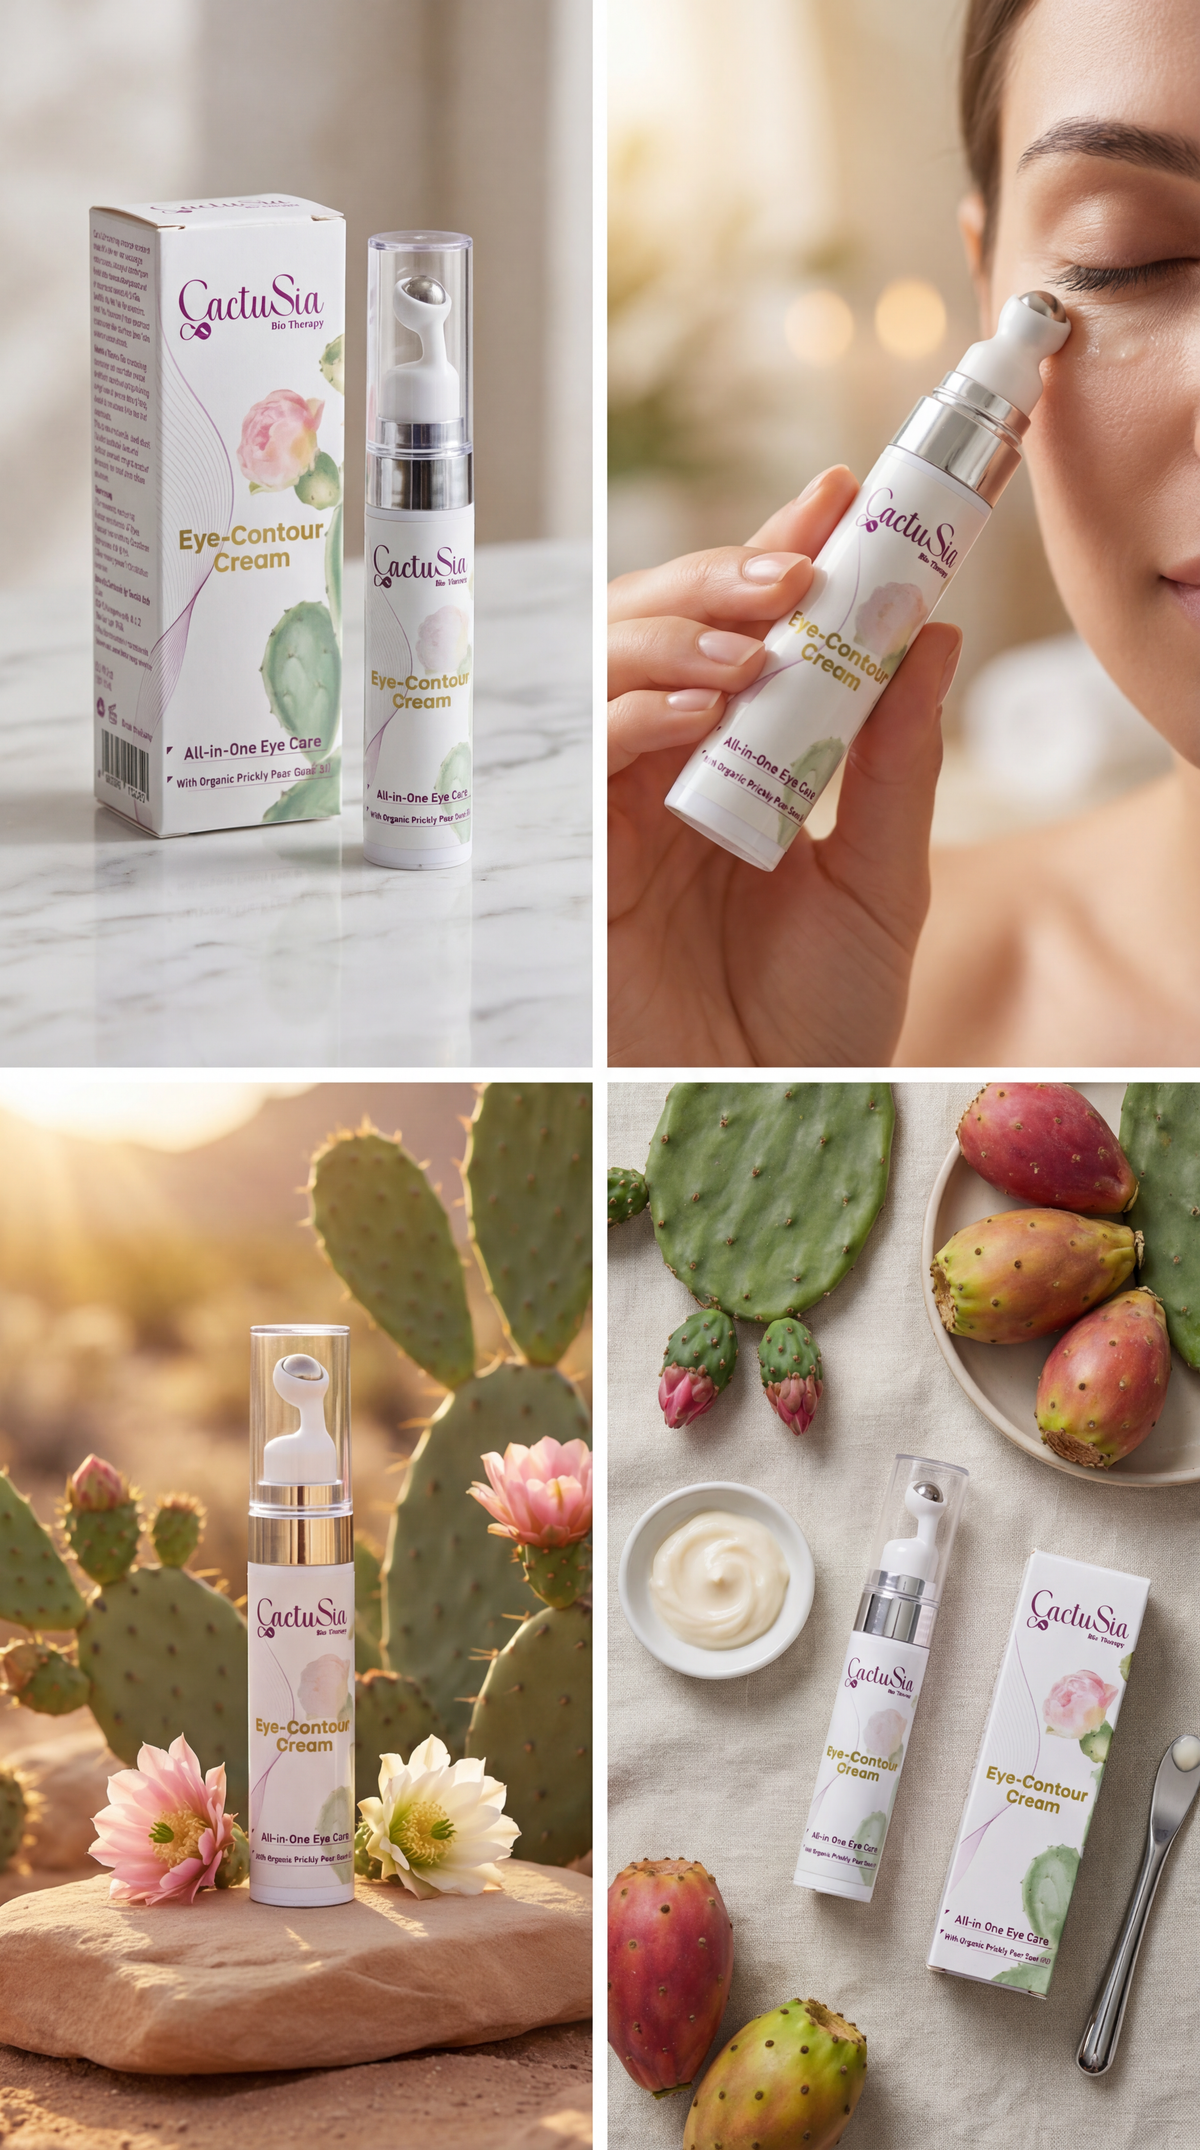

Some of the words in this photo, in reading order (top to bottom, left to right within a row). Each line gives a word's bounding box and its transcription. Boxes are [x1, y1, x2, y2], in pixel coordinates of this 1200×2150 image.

[178, 274, 324, 322] CactuSia
[271, 321, 285, 331] Bio
[288, 320, 324, 331] Therapy
[179, 523, 324, 553] Eye-Contour
[866, 486, 959, 569] CactuSia
[214, 551, 290, 573] Cream
[374, 544, 468, 579] CactuSia
[788, 610, 889, 685] Eye-Contour
[801, 643, 862, 692] Cream
[371, 670, 470, 691] Eye-Contour
[392, 693, 452, 709] Cream
[184, 744, 257, 761] All-in-One
[261, 739, 285, 756] Eye
[290, 736, 322, 750] Care
[723, 736, 779, 775] All-in-One
[779, 768, 799, 788] Eye
[176, 777, 198, 788] With
[199, 773, 235, 788] Organic
[237, 769, 268, 783] Prickly
[377, 789, 429, 803] All-in-One
[431, 792, 450, 805] Eye
[383, 813, 410, 825] Organic
[257, 1598, 347, 1628] CactuSia
[1031, 1590, 1129, 1640] CactuSia
[848, 1657, 914, 1693] CactuSia
[255, 1718, 350, 1737] Eye-Contour
[276, 1737, 333, 1753] Cream
[827, 1746, 898, 1772] Eye-Contour
[837, 1762, 880, 1782] Cream
[986, 1766, 1089, 1803] Eye-Contour
[1006, 1789, 1061, 1814] Cream
[313, 1834, 331, 1846] Eye
[954, 1914, 982, 1930] All-in
[984, 1921, 1004, 1936] One
[1006, 1926, 1025, 1941] Eye
[1026, 1932, 1050, 1947] Care
